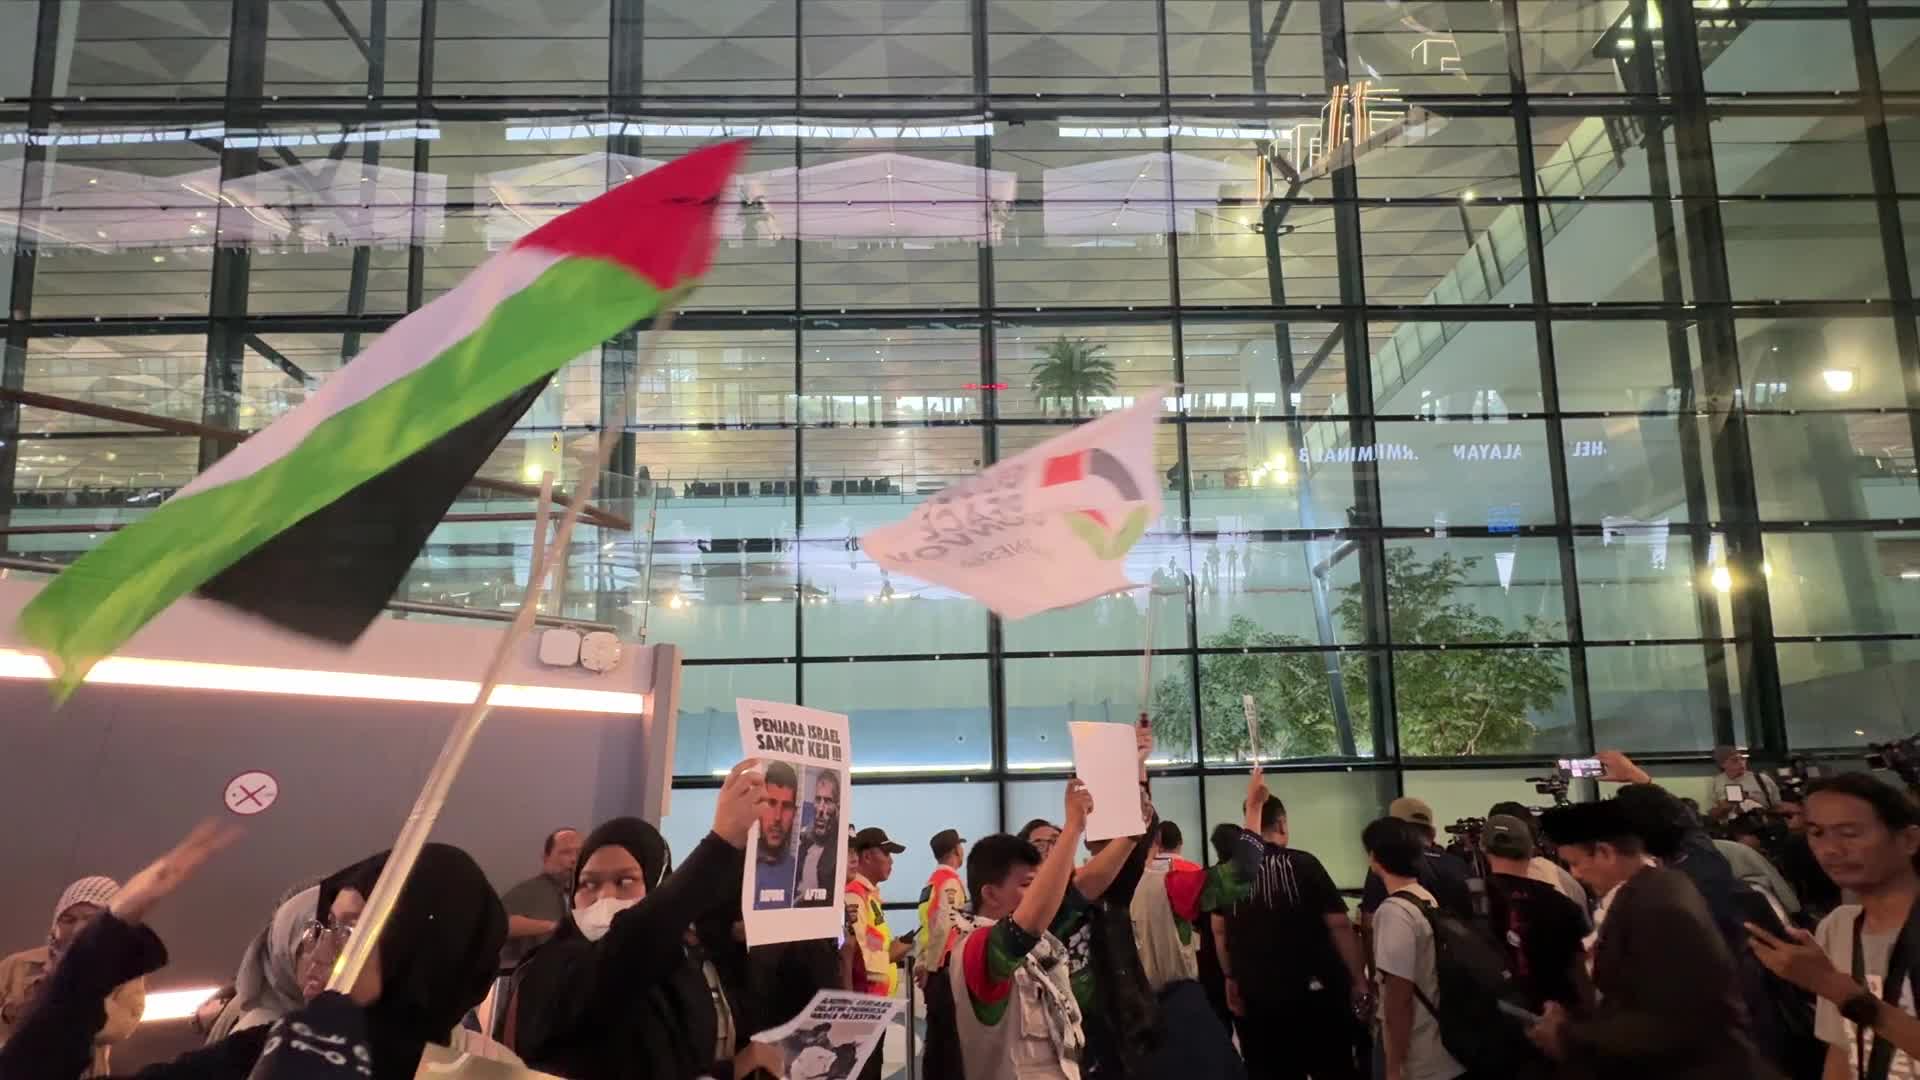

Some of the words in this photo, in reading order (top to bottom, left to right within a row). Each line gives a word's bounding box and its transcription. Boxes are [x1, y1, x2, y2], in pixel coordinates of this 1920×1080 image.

[753, 717, 805, 737] PENJARA
[807, 725, 841, 744] ISRAEL
[808, 741, 829, 760] KEJI
